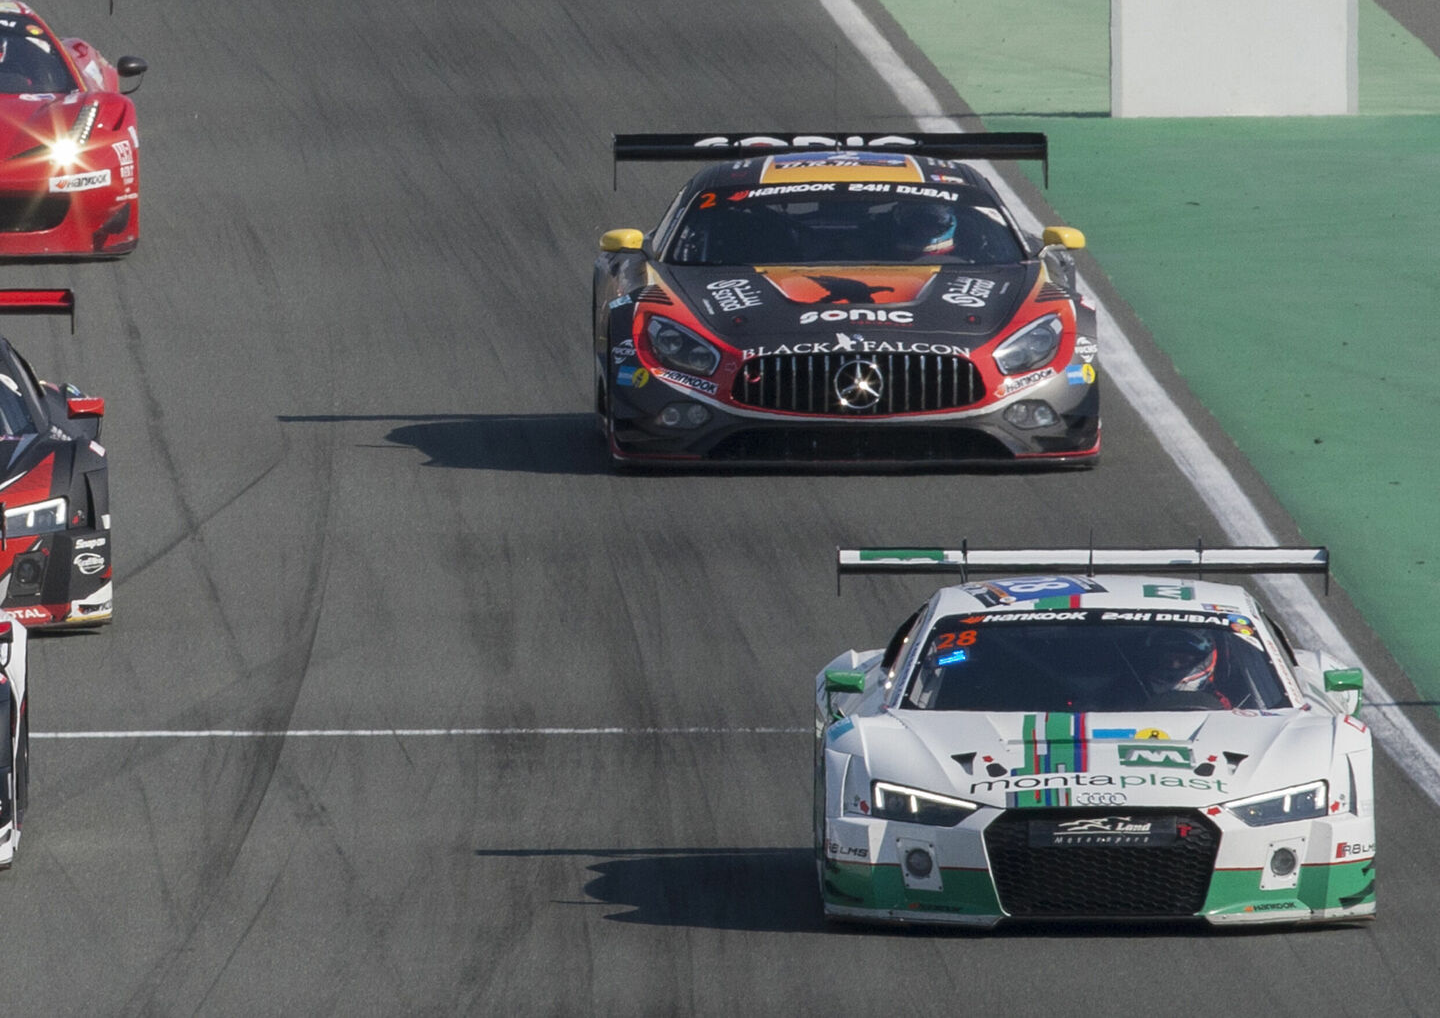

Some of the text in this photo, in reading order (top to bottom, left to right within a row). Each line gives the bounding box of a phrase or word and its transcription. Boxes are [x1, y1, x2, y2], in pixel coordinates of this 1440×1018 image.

[698, 192, 717, 210] 2
[847, 183, 891, 193] 24H
[895, 184, 959, 202] DUBAI
[741, 340, 971, 360] BLACK FALCON
[9, 607, 47, 619] OTAL
[1100, 611, 1153, 622] 24H
[1154, 612, 1231, 627] DUBAI
[936, 629, 979, 650] 28
[968, 772, 1230, 795] montaplast
[1113, 821, 1152, 833] Land
[1053, 834, 1151, 845] Motorsport
[839, 846, 869, 858] LMS
